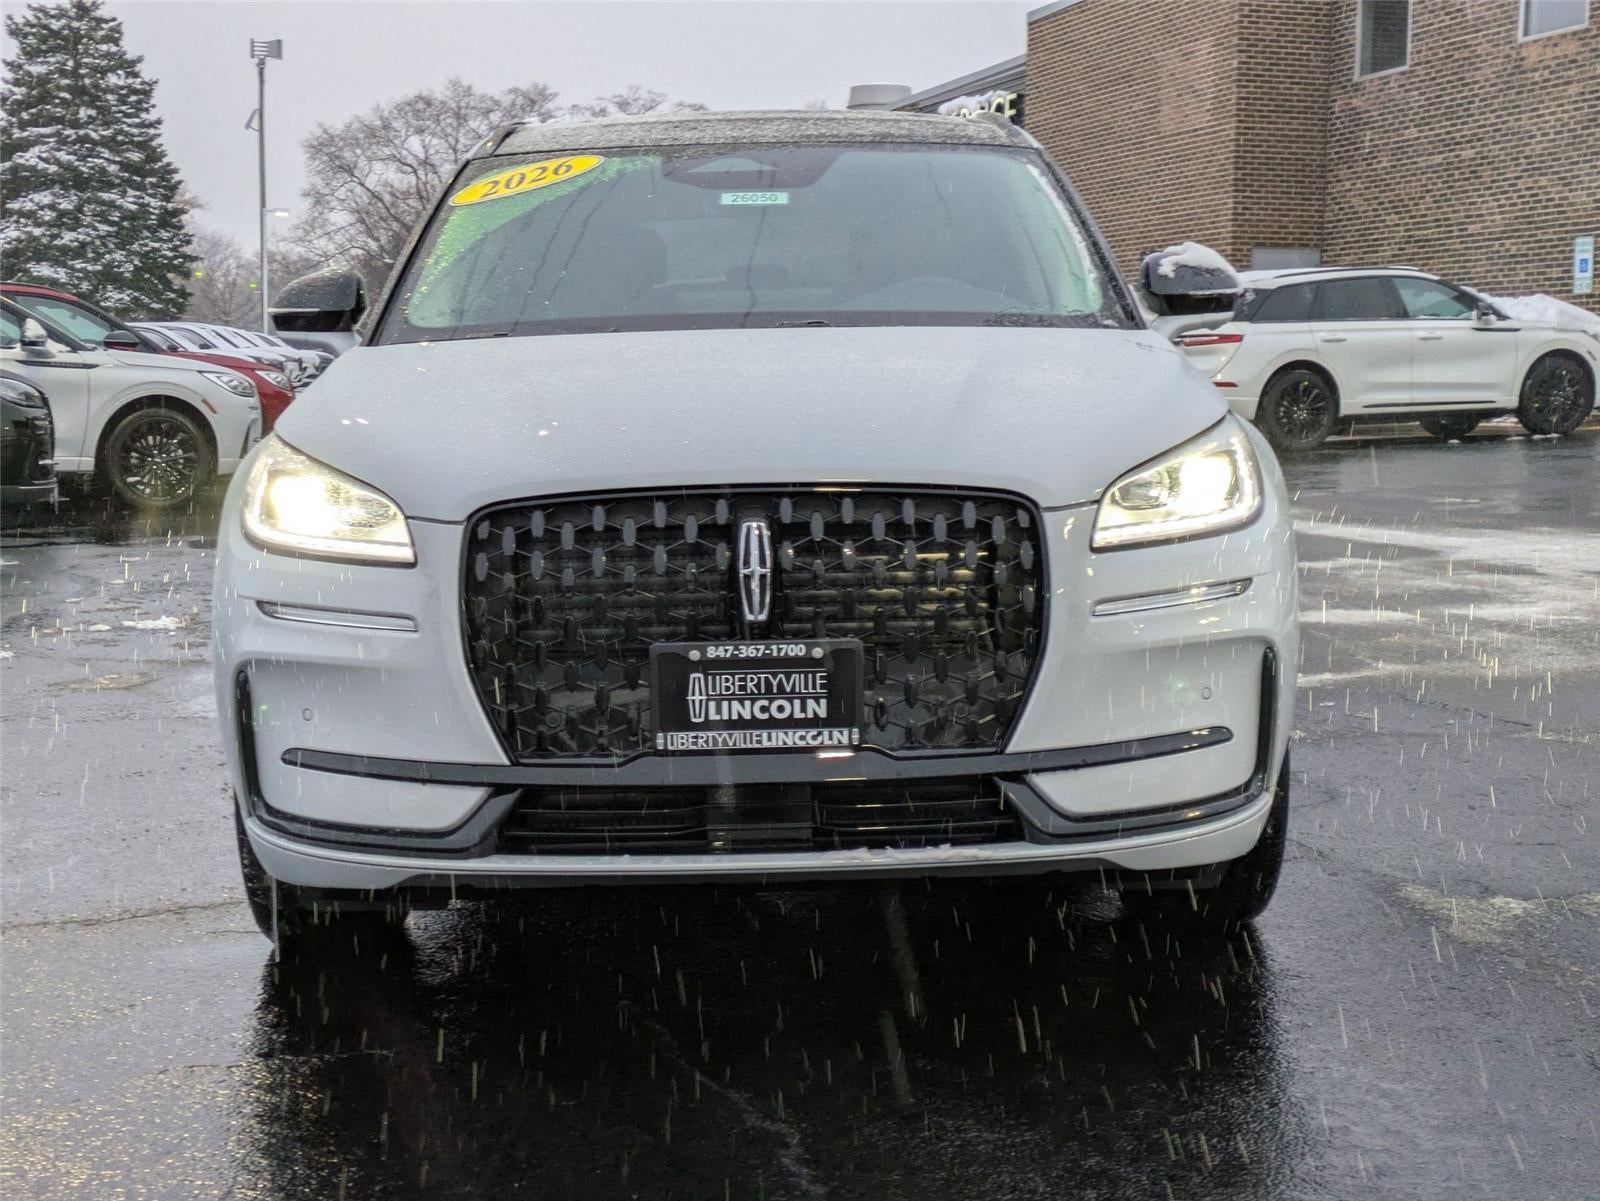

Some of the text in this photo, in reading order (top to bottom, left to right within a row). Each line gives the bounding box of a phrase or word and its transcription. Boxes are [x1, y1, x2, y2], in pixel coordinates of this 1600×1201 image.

[479, 158, 574, 199] 2026
[730, 193, 779, 203] 26050
[706, 644, 806, 658] 847-367-1700
[708, 673, 828, 695] LIBERTYVILLE
[708, 698, 828, 720] LINCOLN
